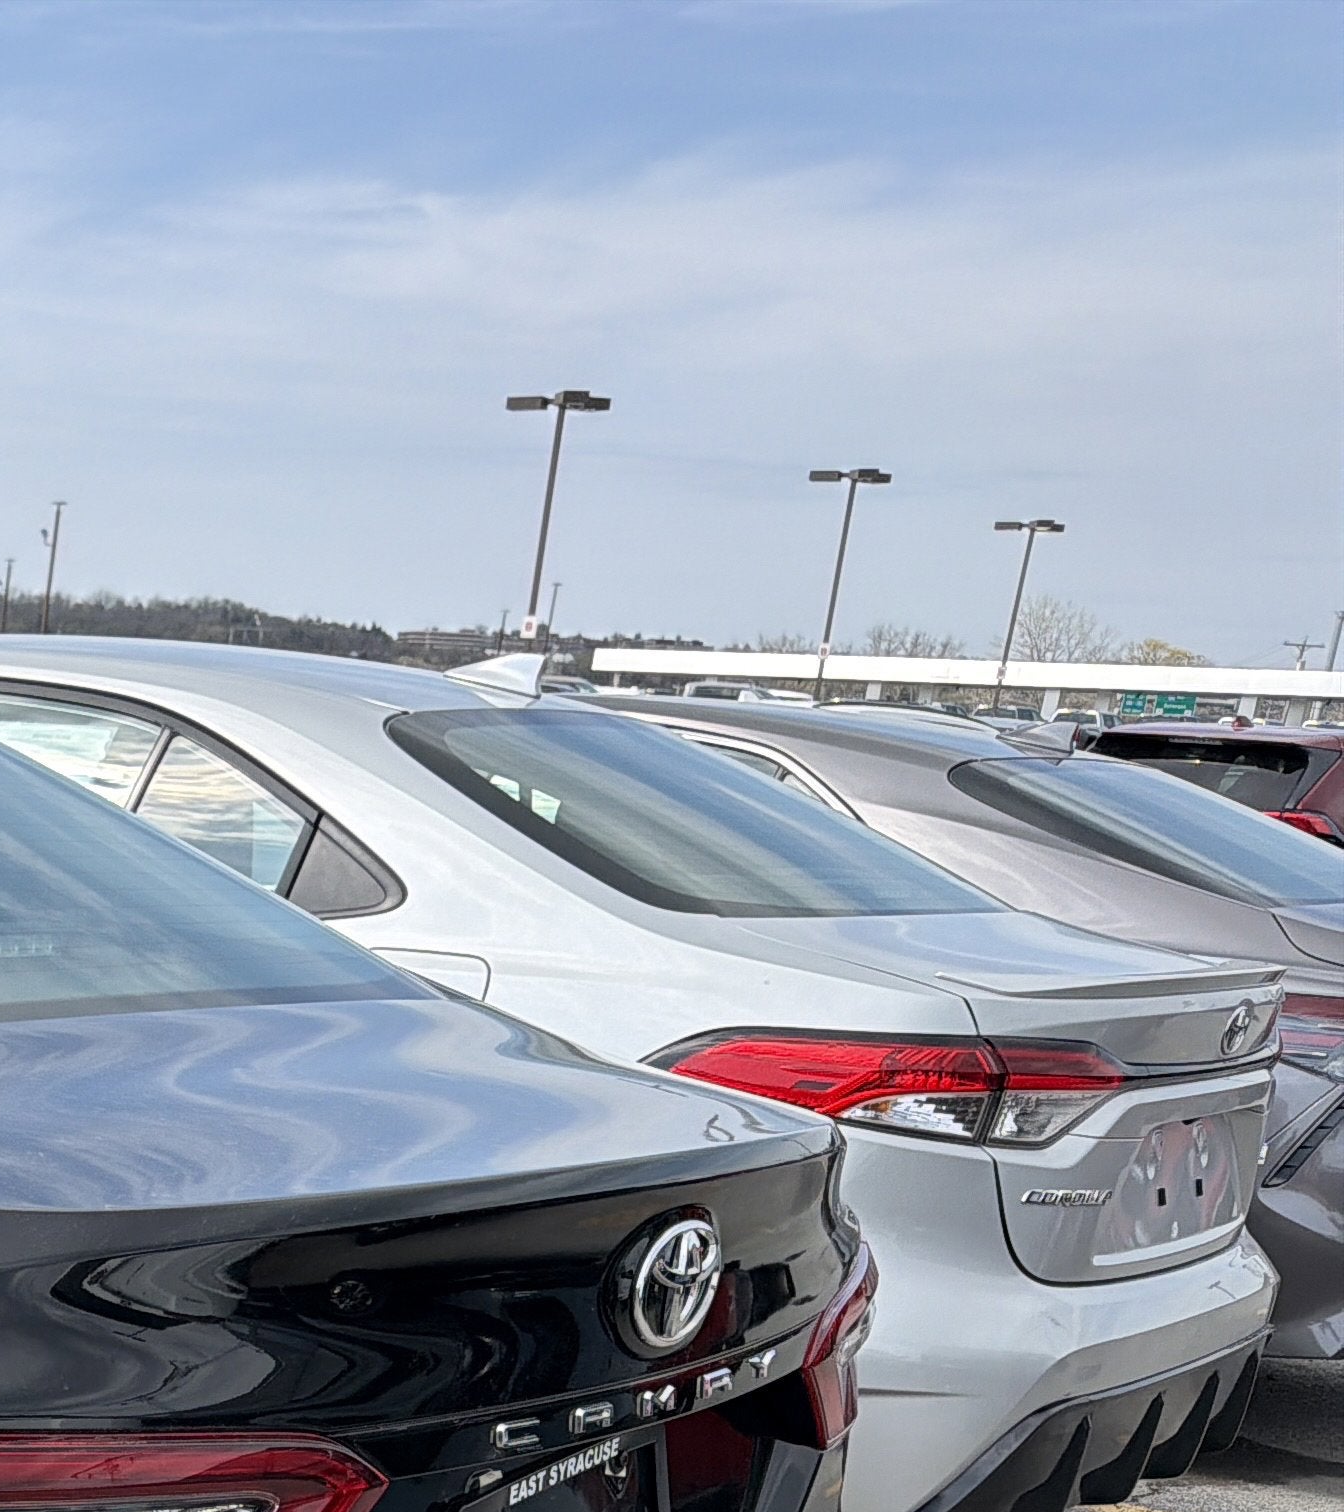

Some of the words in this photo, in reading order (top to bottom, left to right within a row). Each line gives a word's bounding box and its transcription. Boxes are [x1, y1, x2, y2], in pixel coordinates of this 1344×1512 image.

[490, 1349, 777, 1449] CAMRY
[509, 1469, 548, 1506] EAST
[548, 1437, 622, 1487] SYRACUSE
